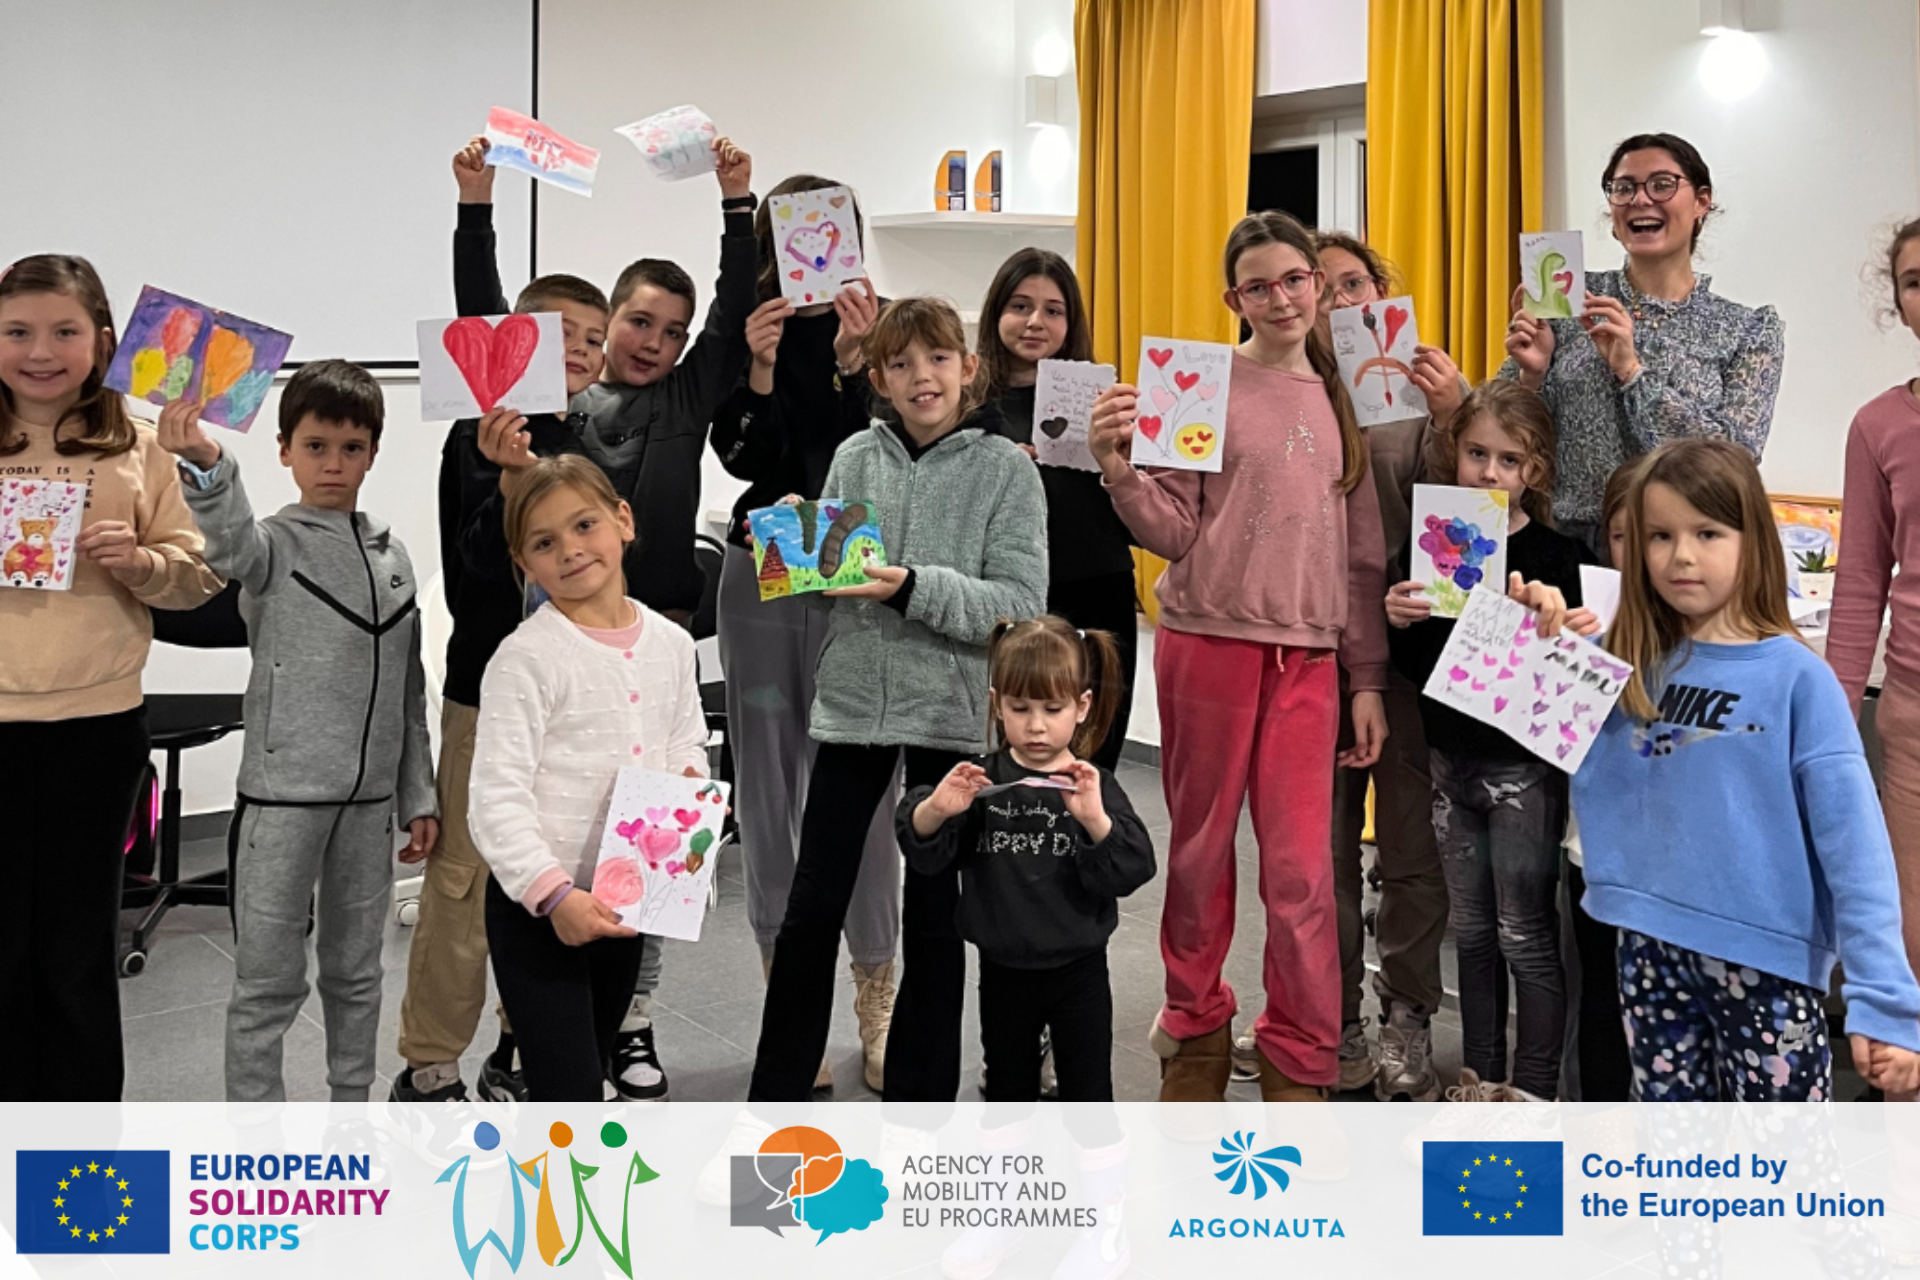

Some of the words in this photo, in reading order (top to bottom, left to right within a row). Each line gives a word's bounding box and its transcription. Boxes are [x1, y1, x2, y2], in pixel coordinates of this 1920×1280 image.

[57, 467, 70, 475] IS
[1657, 684, 1741, 731] NIKE
[988, 800, 1019, 819] make
[1022, 800, 1059, 829] today
